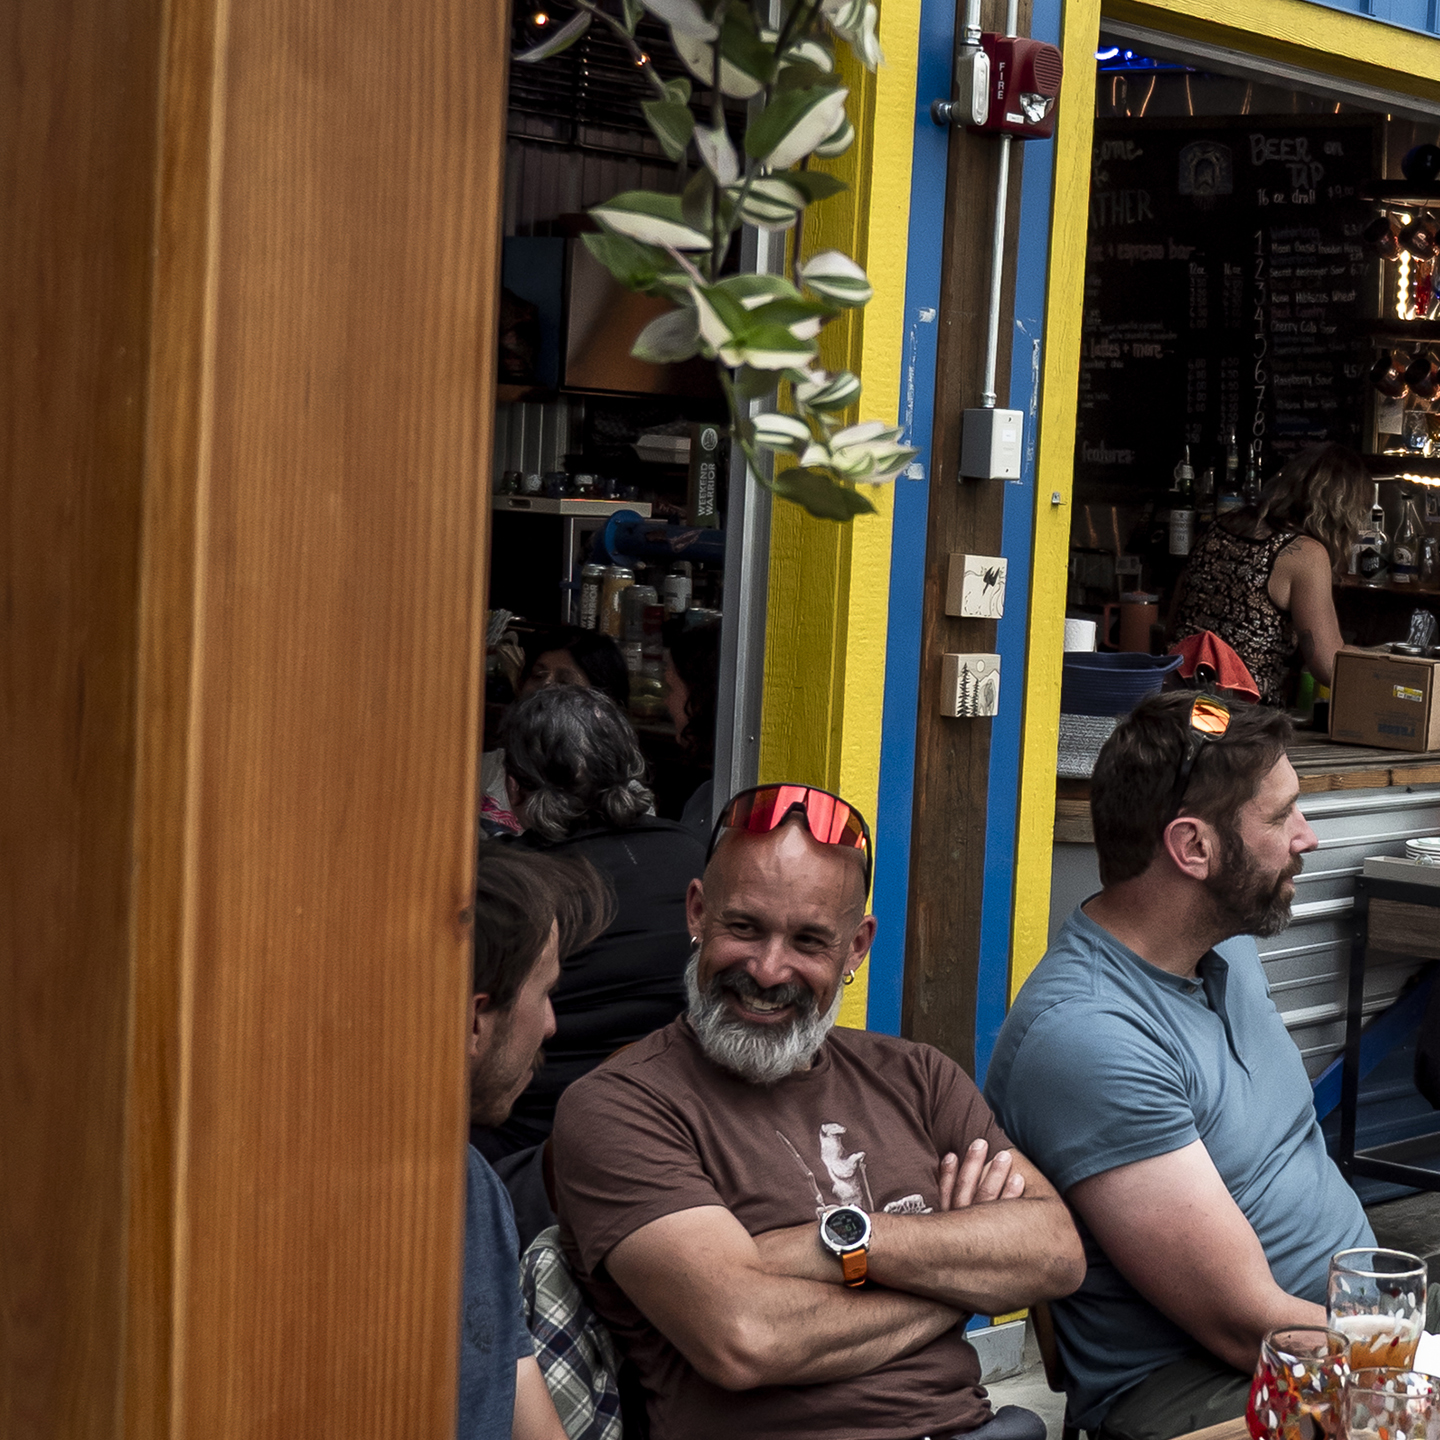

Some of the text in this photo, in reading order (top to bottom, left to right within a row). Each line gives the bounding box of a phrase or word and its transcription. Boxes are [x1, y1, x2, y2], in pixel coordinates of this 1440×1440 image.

[997, 62, 1006, 100] FIRE
[1249, 133, 1313, 166] BEER
[1286, 161, 1325, 190] TAP
[1092, 189, 1154, 230] THER
[1257, 188, 1269, 206] 16
[1254, 229, 1264, 256] 1
[1254, 258, 1265, 280] 2
[1254, 281, 1266, 306] 3
[1254, 306, 1265, 332] 4
[1270, 320, 1298, 335] Cherry
[1253, 333, 1267, 359] 5
[1254, 359, 1267, 384] 6
[1254, 385, 1266, 411] 7
[1252, 410, 1266, 437] 8
[698, 462, 708, 516] WEEKEND
[705, 463, 716, 516] WARRIOR
